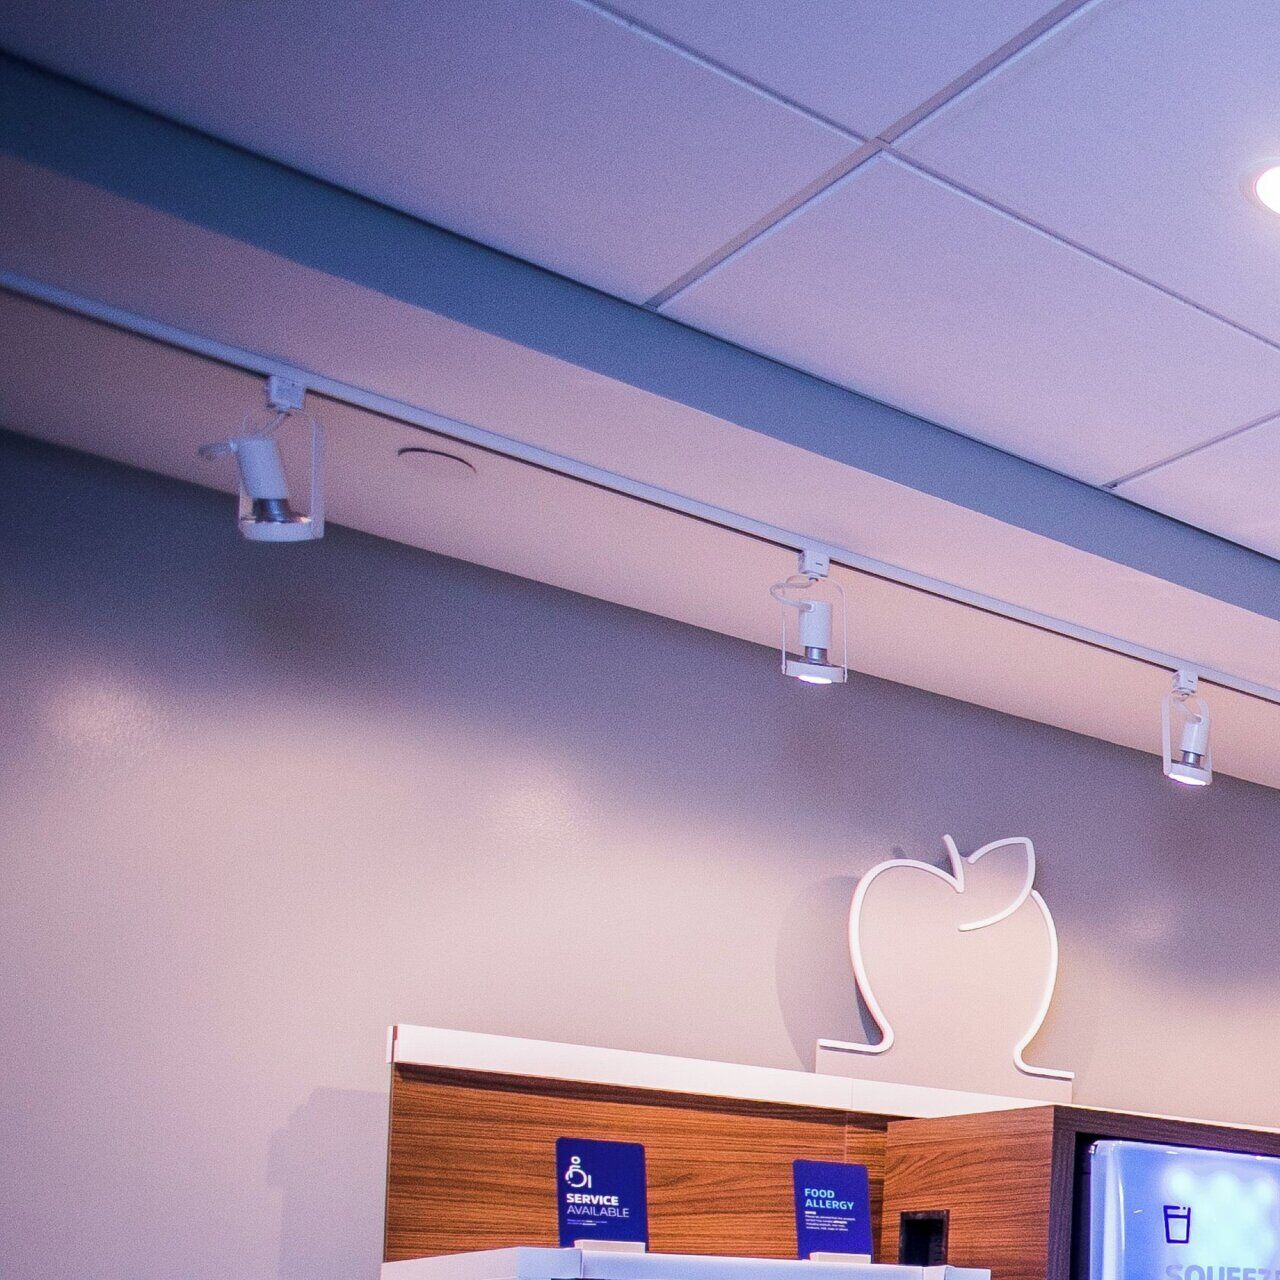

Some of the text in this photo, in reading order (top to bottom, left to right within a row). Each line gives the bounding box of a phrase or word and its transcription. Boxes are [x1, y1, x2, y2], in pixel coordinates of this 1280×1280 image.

[805, 1188, 835, 1198] FOOD
[566, 1193, 619, 1206] SERVICE
[805, 1199, 854, 1210] ALLERGY
[566, 1205, 629, 1218] AVAILABLE
